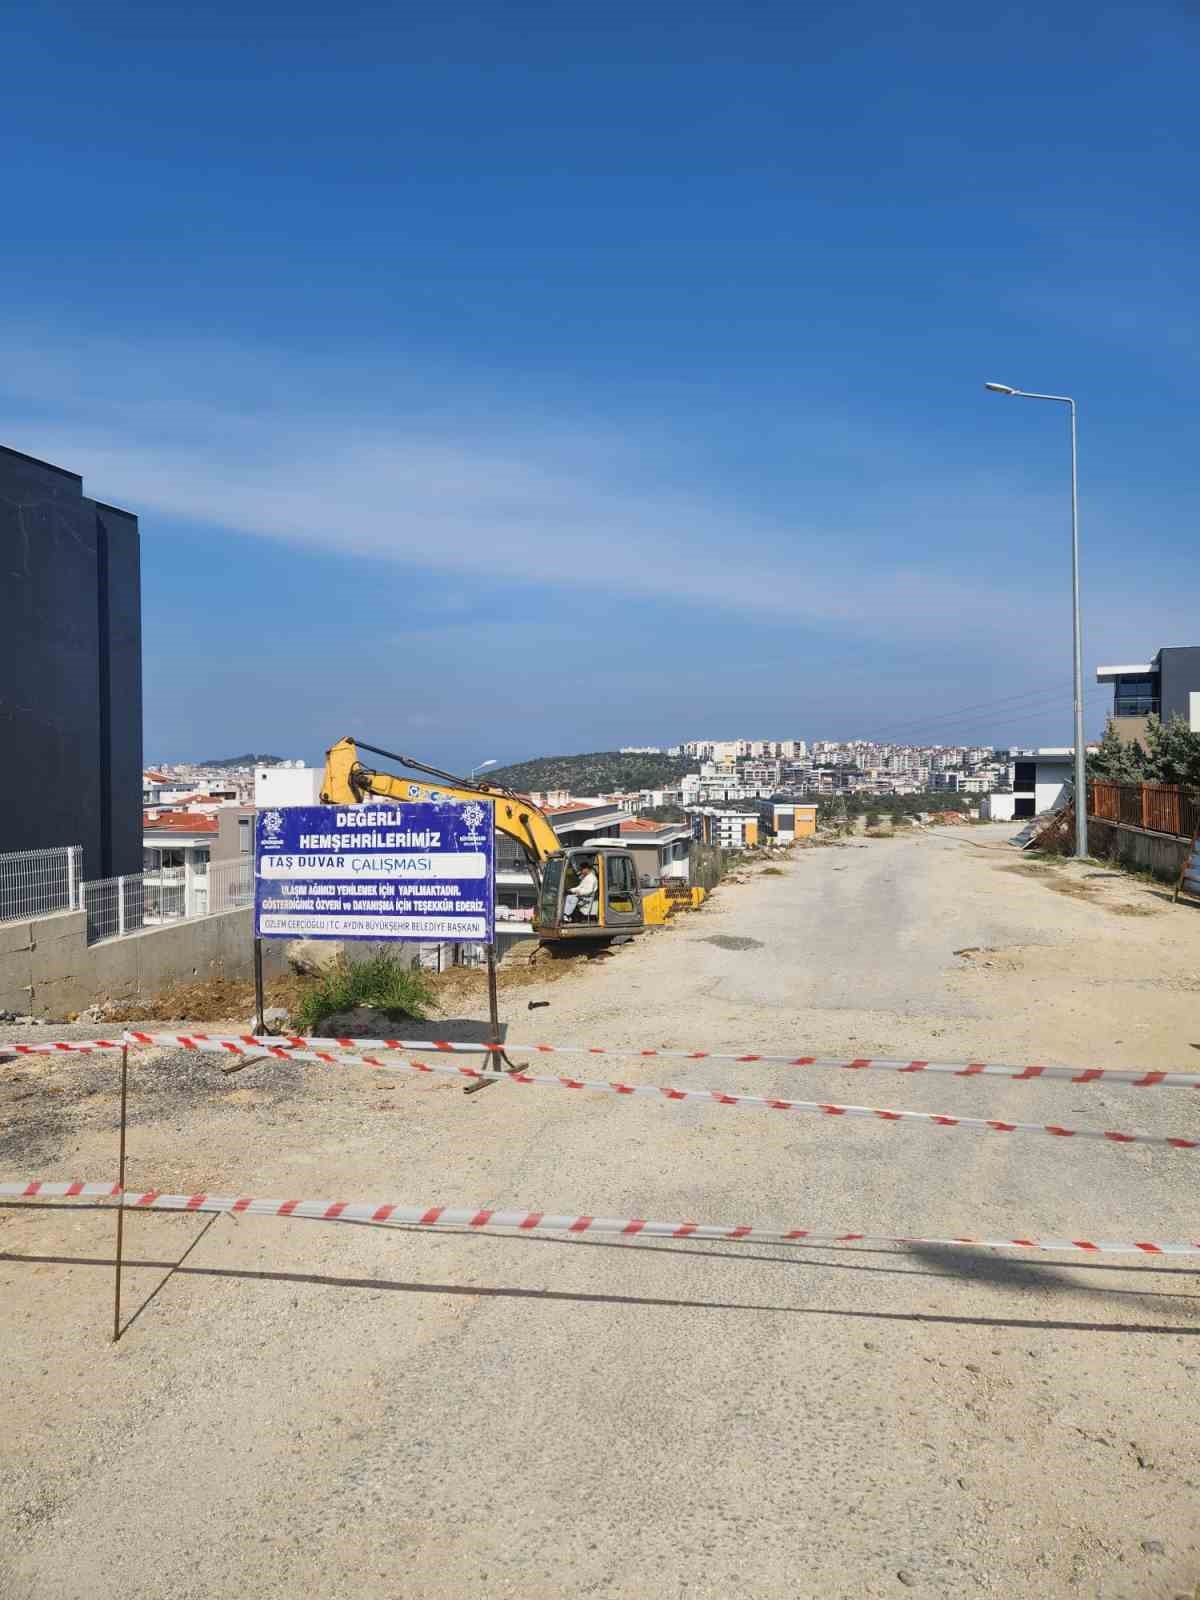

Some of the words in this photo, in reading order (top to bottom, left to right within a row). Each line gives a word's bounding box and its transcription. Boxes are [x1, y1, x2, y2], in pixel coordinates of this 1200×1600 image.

[336, 808, 401, 828] DEĞERLİ
[300, 828, 441, 853] HEMŞEHRİLERİMİZ
[268, 856, 294, 870] TAŞ
[298, 856, 345, 868] DUVAR
[351, 858, 432, 873] ÇALIŞMASI
[414, 898, 454, 915] TEŞEKKÜR
